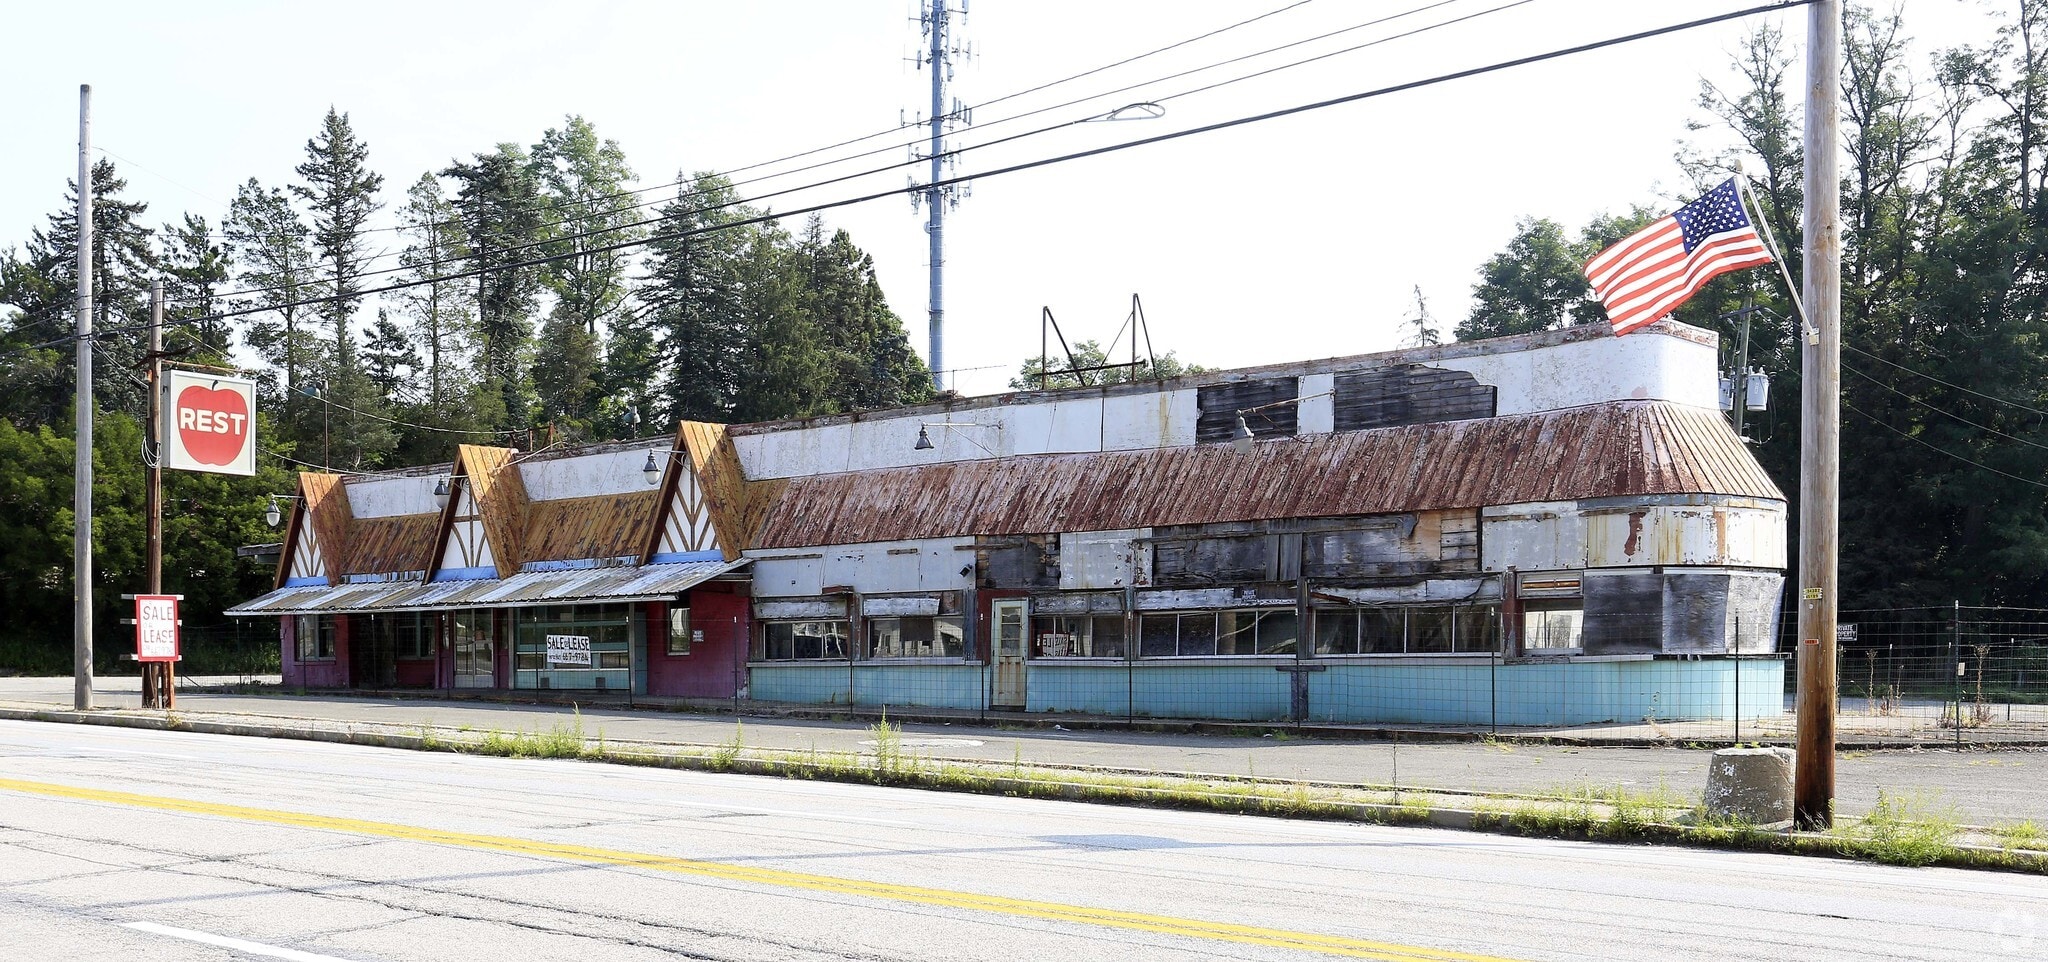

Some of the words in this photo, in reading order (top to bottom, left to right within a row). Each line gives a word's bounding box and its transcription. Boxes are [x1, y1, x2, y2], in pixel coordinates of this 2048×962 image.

[180, 407, 246, 436] REST
[143, 606, 173, 620] SALE
[143, 630, 174, 643] LEASE
[548, 636, 564, 650] SALE
[568, 638, 590, 650] LEASE
